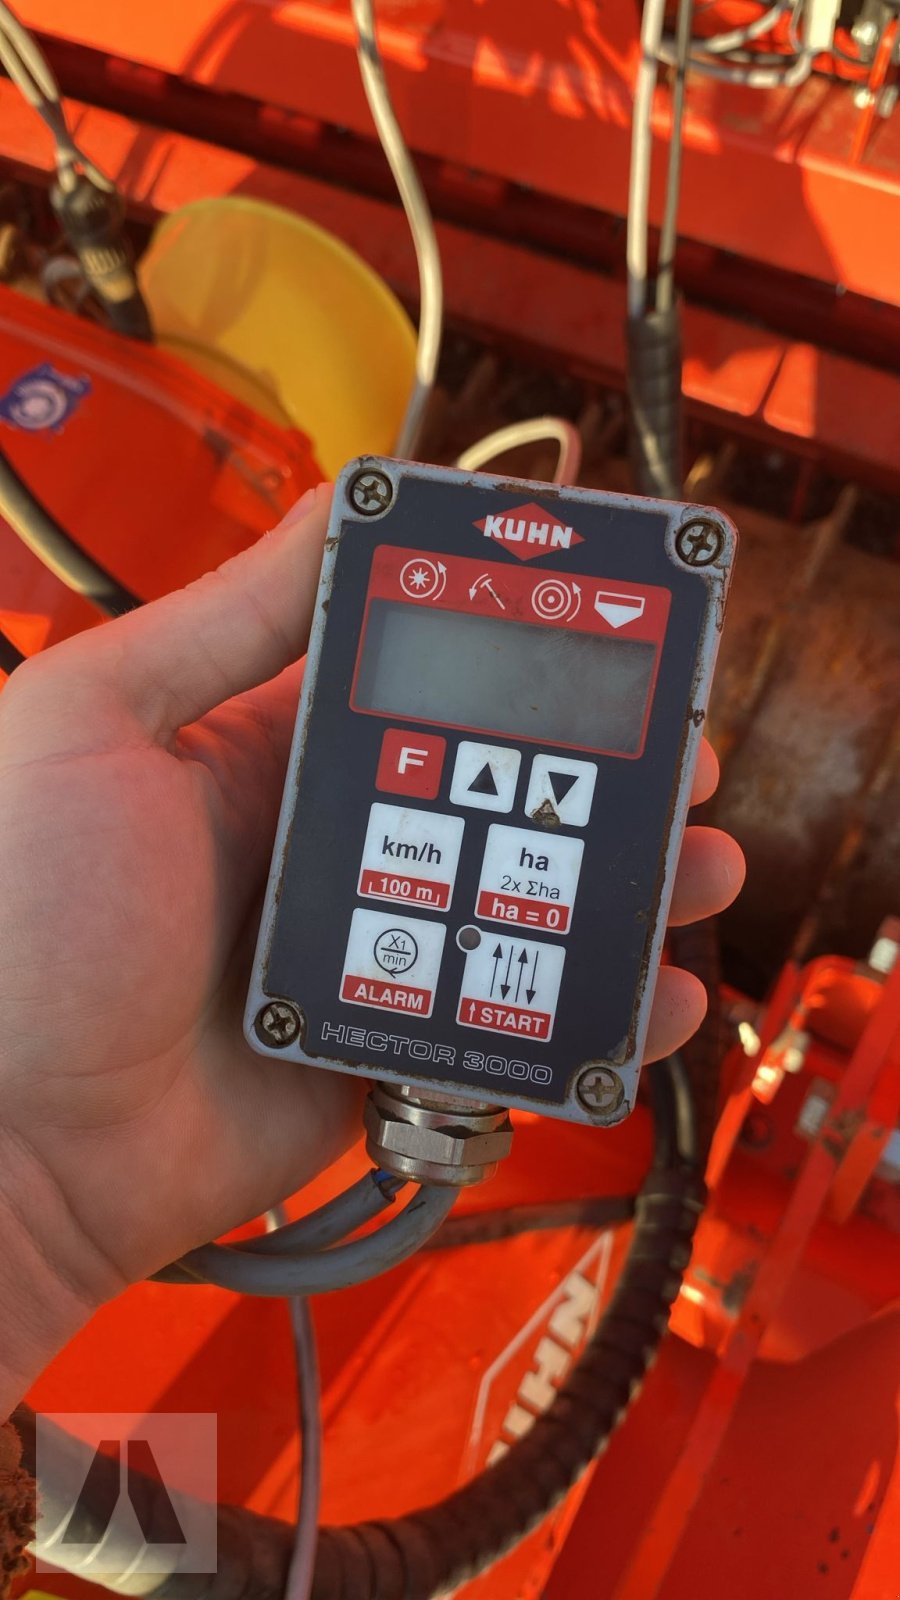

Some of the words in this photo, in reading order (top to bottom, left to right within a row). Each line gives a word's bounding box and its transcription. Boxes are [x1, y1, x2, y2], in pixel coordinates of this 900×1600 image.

[483, 514, 573, 549] KUHN
[397, 746, 429, 775] F
[381, 835, 442, 864] km/h
[519, 847, 549, 871] ha
[380, 877, 411, 896] 100
[416, 886, 433, 901] m
[491, 898, 519, 920] ha
[382, 953, 407, 967] min
[354, 984, 423, 1010] ALARM
[480, 1007, 545, 1034] START
[321, 1022, 457, 1066] HECTOR
[462, 1050, 553, 1085] 3000
